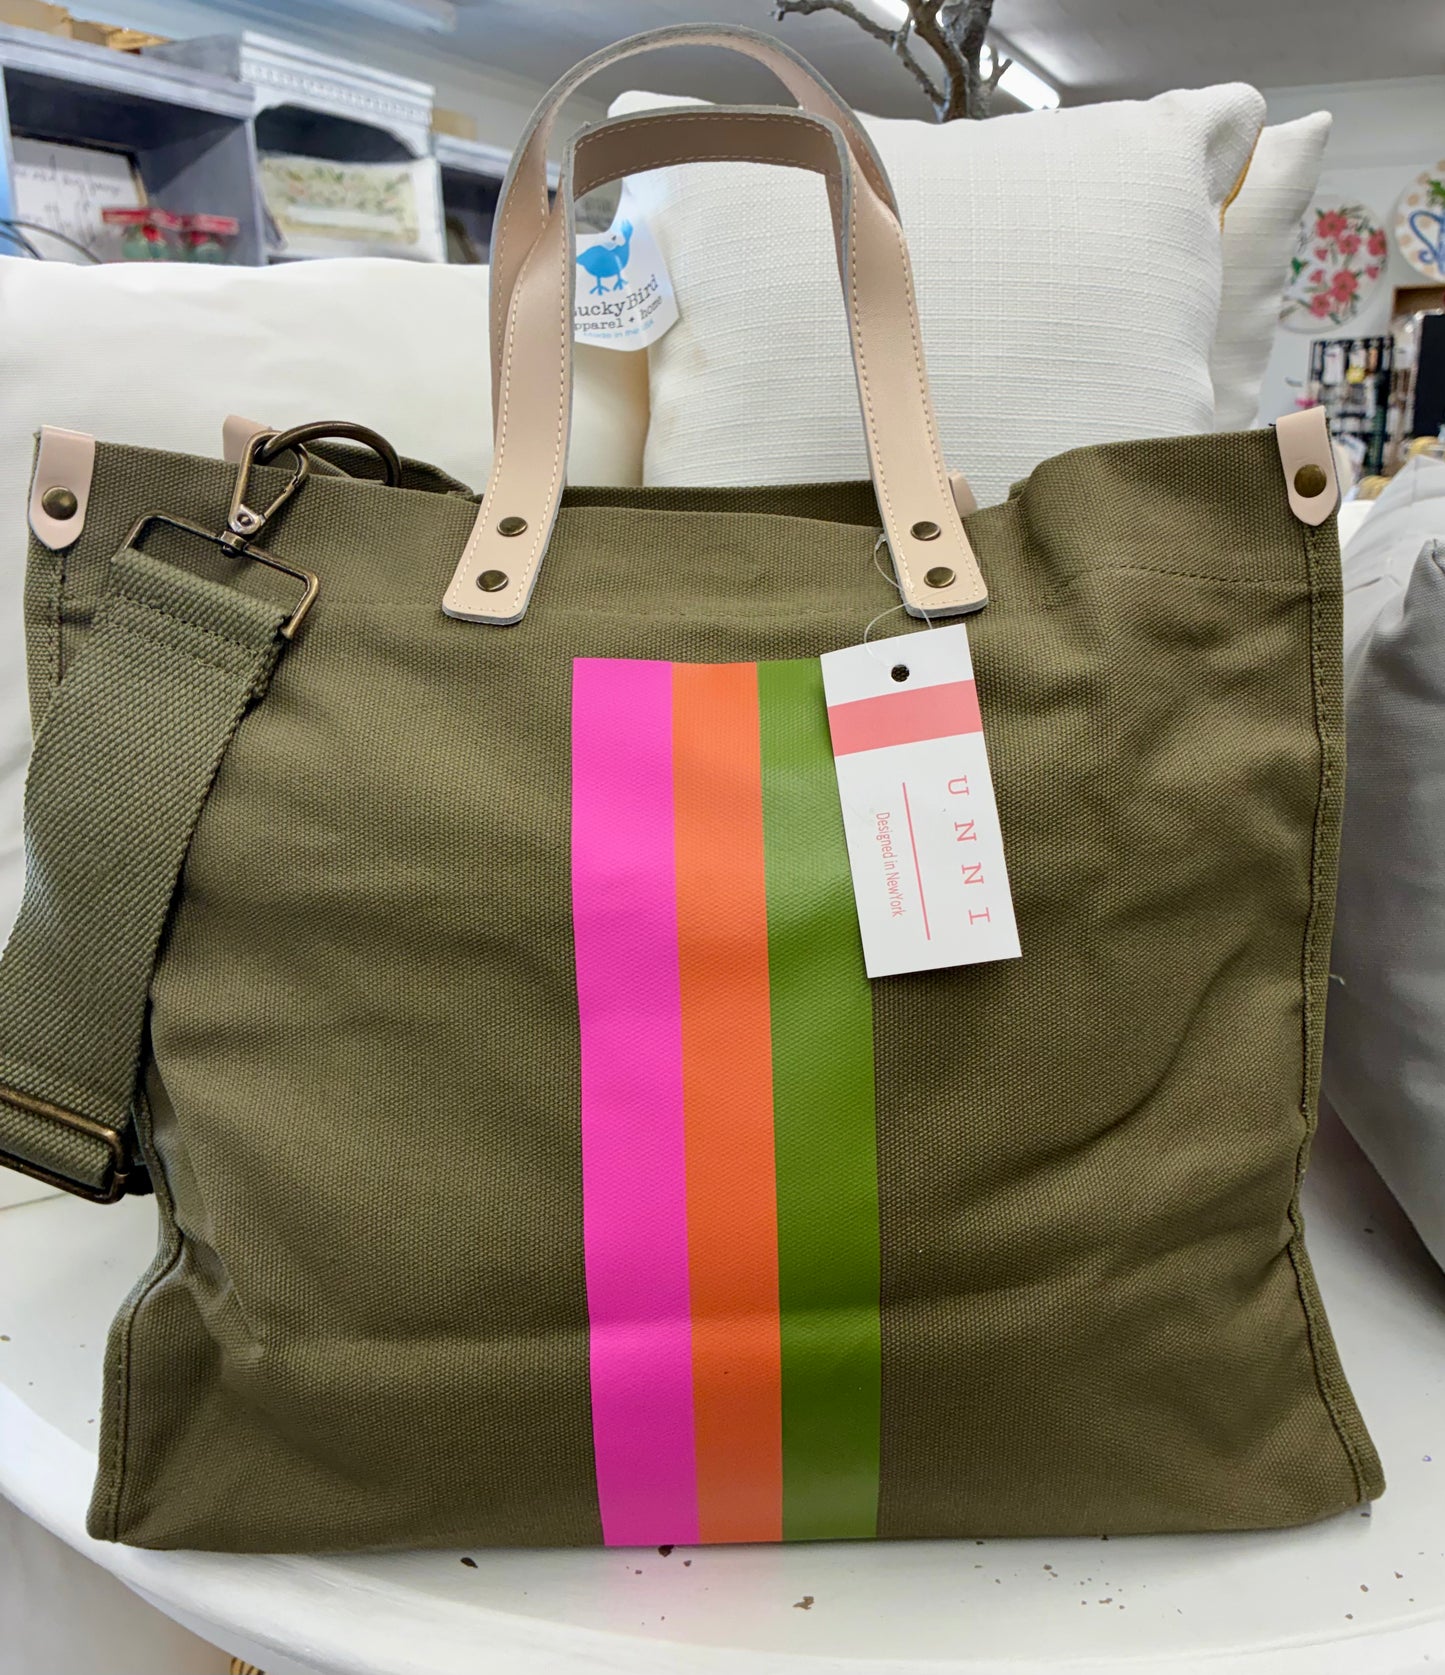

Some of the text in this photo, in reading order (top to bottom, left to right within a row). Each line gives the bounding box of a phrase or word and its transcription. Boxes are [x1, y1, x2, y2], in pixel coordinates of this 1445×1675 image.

[574, 273, 658, 317] uckyBird
[574, 318, 624, 332] pparel
[875, 812, 898, 859] Designed
[947, 774, 991, 925] UNNI
[884, 860, 897, 870] in
